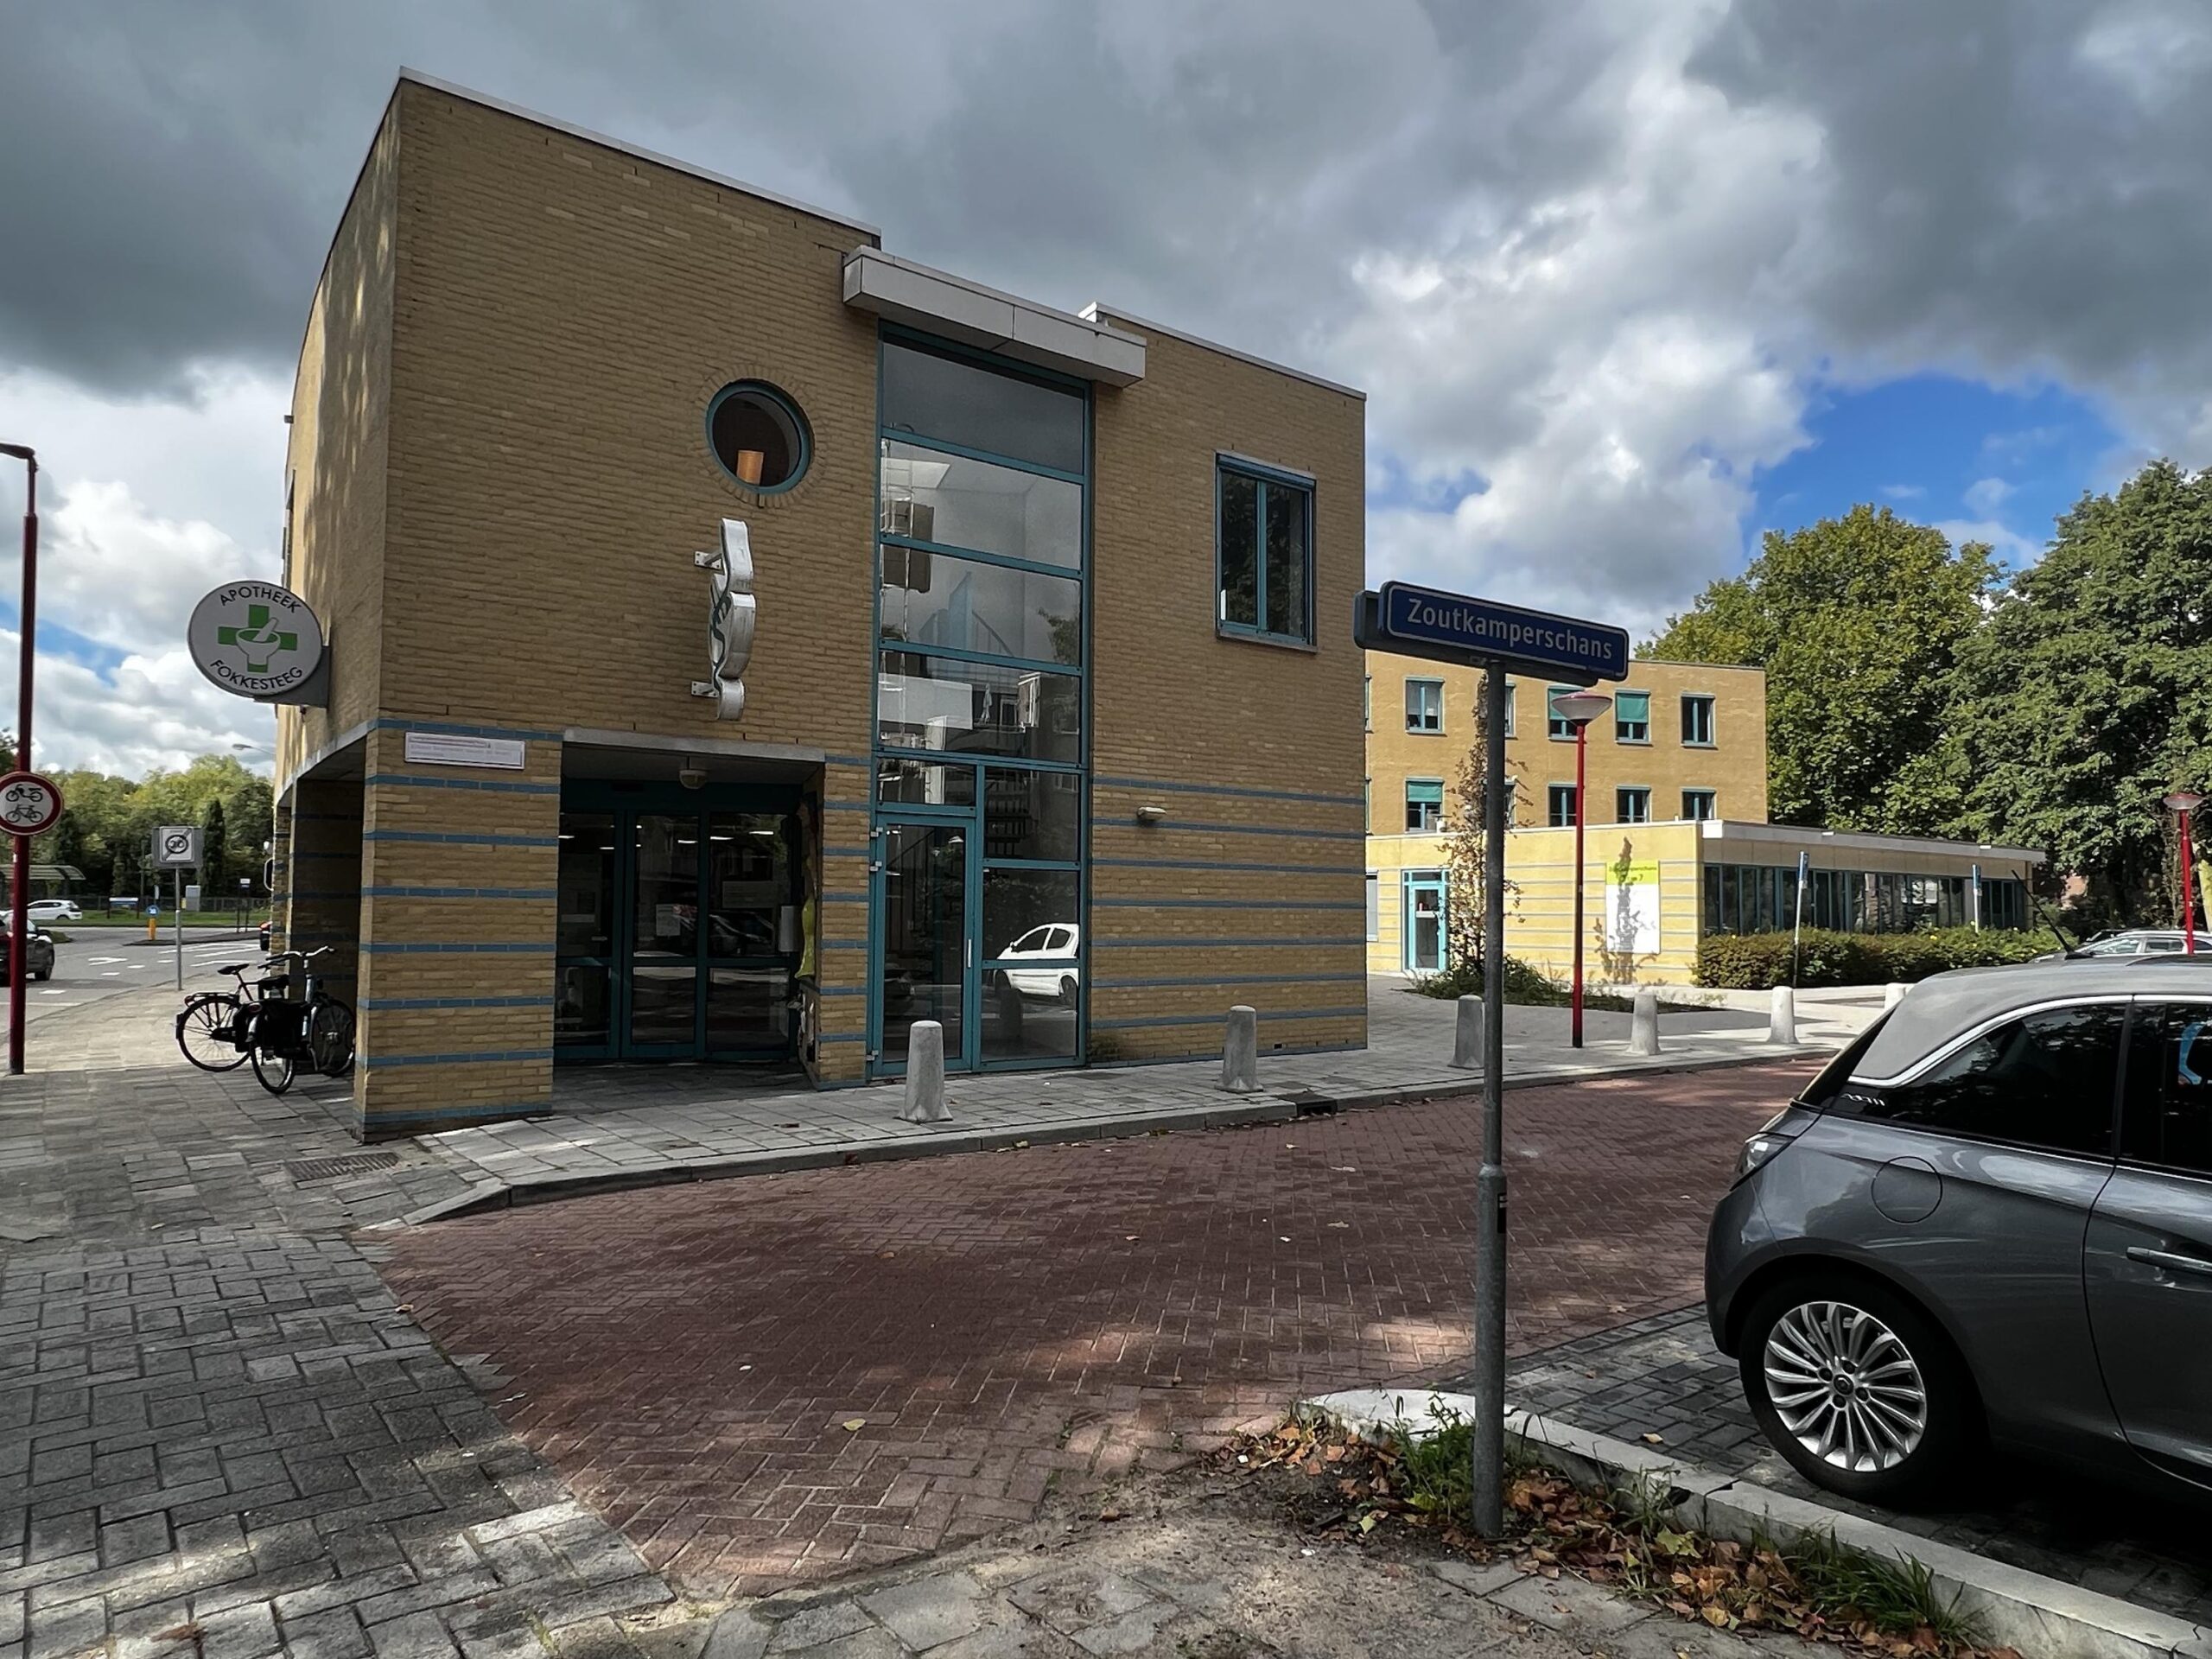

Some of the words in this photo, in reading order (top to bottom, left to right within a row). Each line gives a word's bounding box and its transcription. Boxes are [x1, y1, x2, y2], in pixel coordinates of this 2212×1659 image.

[219, 586, 302, 613] APOTHEEK
[1407, 598, 1612, 660] Zoutkamperschans
[210, 659, 302, 690] FOKKESTEEG
